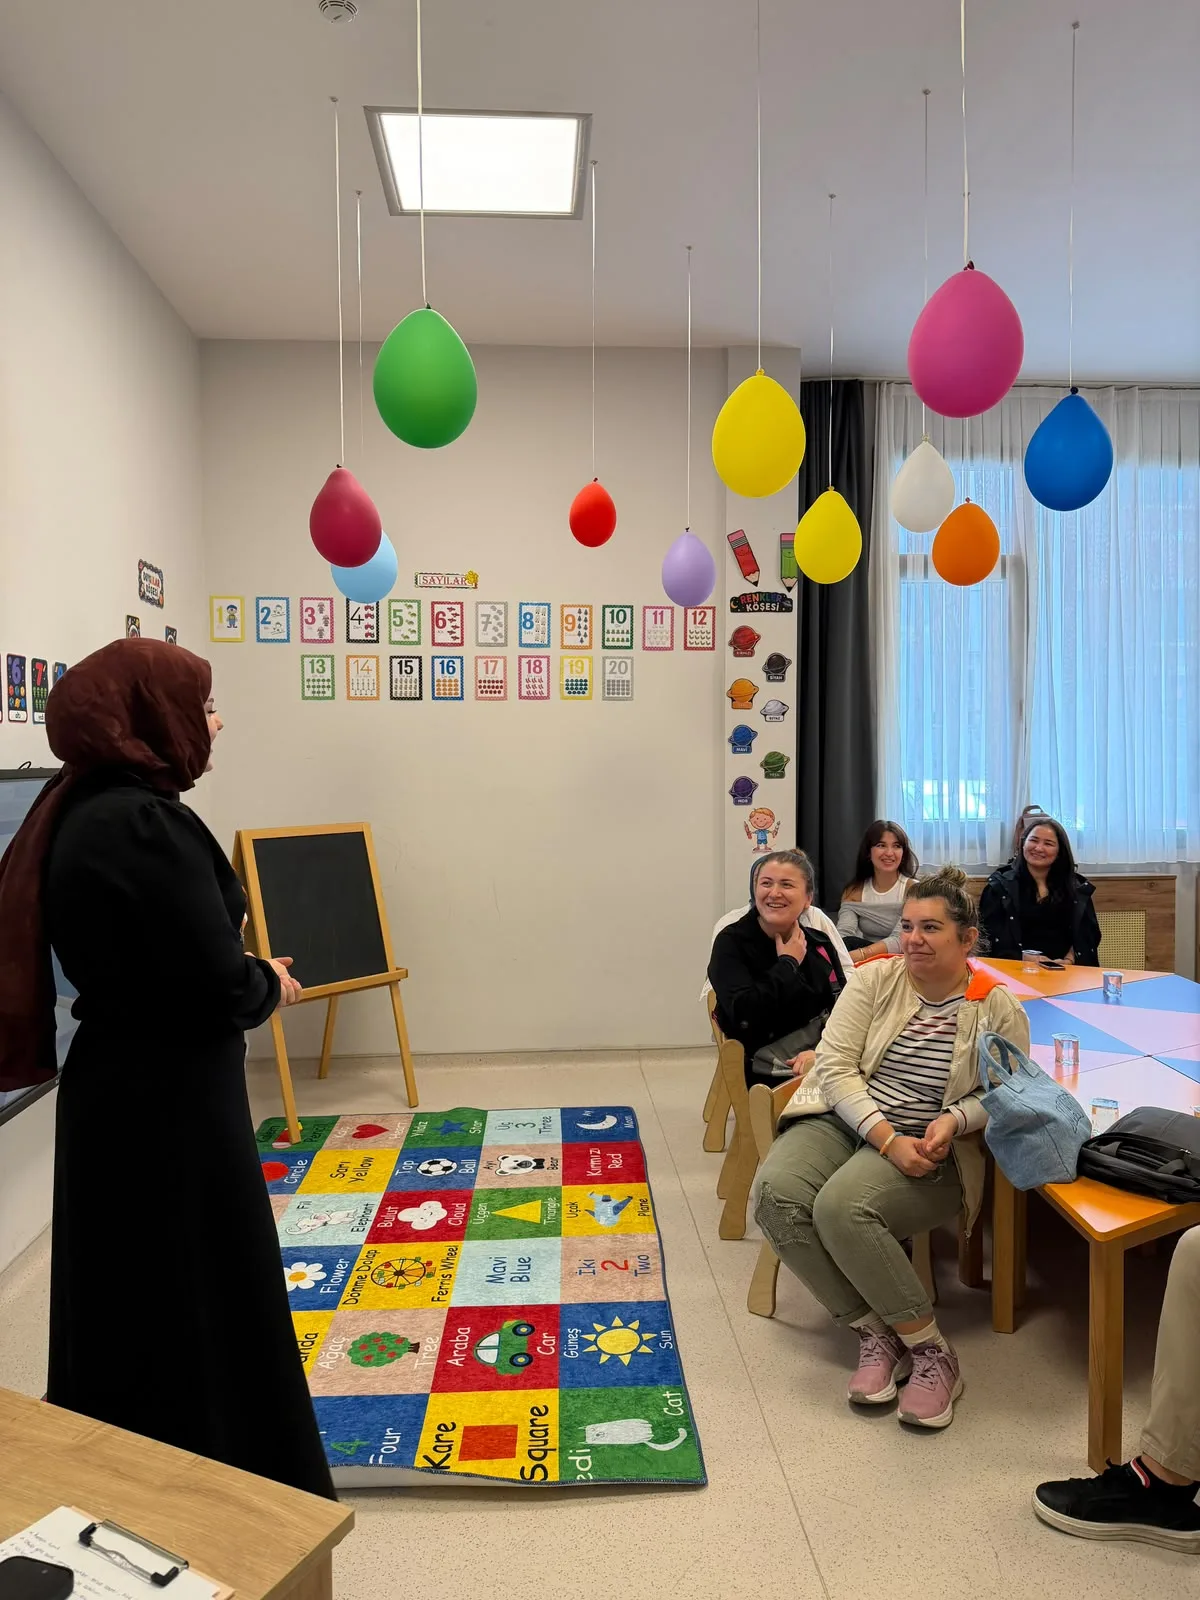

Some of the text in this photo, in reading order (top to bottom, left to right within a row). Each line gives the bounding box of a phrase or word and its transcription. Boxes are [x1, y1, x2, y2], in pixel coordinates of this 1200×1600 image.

[422, 575, 467, 586] SAYILAR
[740, 593, 782, 604] RENKLER
[746, 602, 780, 612] KÖŞESİ
[216, 606, 224, 624] 1
[260, 606, 272, 624] 2
[304, 607, 316, 625] 3
[350, 606, 365, 626] 4
[393, 609, 404, 627] 5
[435, 611, 447, 629] 6
[481, 614, 493, 632] 7
[522, 612, 535, 630] 8
[564, 614, 576, 632] 9
[609, 609, 627, 624] 10
[652, 610, 665, 625] 11
[691, 610, 707, 625] 12
[11, 658, 21, 685] 6
[35, 662, 43, 686] 7
[309, 659, 326, 674] 13
[353, 659, 372, 675] 14
[397, 660, 414, 675] 15
[440, 660, 456, 674] 16
[483, 660, 498, 674] 17
[526, 659, 543, 674] 18
[568, 660, 584, 674] 19
[608, 660, 628, 675] 20
[469, 1120, 482, 1134] Star
[515, 1121, 536, 1129] 3
[539, 1115, 552, 1134] Three
[330, 1161, 351, 1179] Sarı
[348, 1156, 375, 1183] Yellow
[395, 1160, 419, 1176] Top
[458, 1159, 477, 1174] Ball
[546, 1156, 559, 1171] Bear
[607, 1153, 623, 1169] Red
[283, 1159, 308, 1184] Circle
[377, 1205, 400, 1228] Bulut
[448, 1202, 467, 1226] Cloud
[543, 1197, 560, 1225] Triangle
[566, 1201, 582, 1219] Uçak
[637, 1198, 652, 1217] Plane
[351, 1203, 376, 1233] Elephant
[431, 1245, 459, 1303] Ferris Wheel
[486, 1256, 507, 1284] Mavi
[510, 1256, 532, 1283] Blue
[575, 1258, 596, 1276] İki
[600, 1259, 629, 1271] 2
[634, 1254, 651, 1277] Two
[319, 1258, 350, 1295] Flower
[342, 1249, 381, 1306] Dönme Dolap
[446, 1326, 472, 1367] Araba
[536, 1332, 556, 1356] Car
[564, 1327, 582, 1359] Güneş
[659, 1329, 673, 1349] Sun
[319, 1335, 351, 1370] Ağaç
[413, 1336, 440, 1370] Tree
[663, 1390, 682, 1416] Cat
[330, 1438, 371, 1456] 4
[421, 1421, 457, 1471] Kare
[520, 1404, 550, 1482] Square
